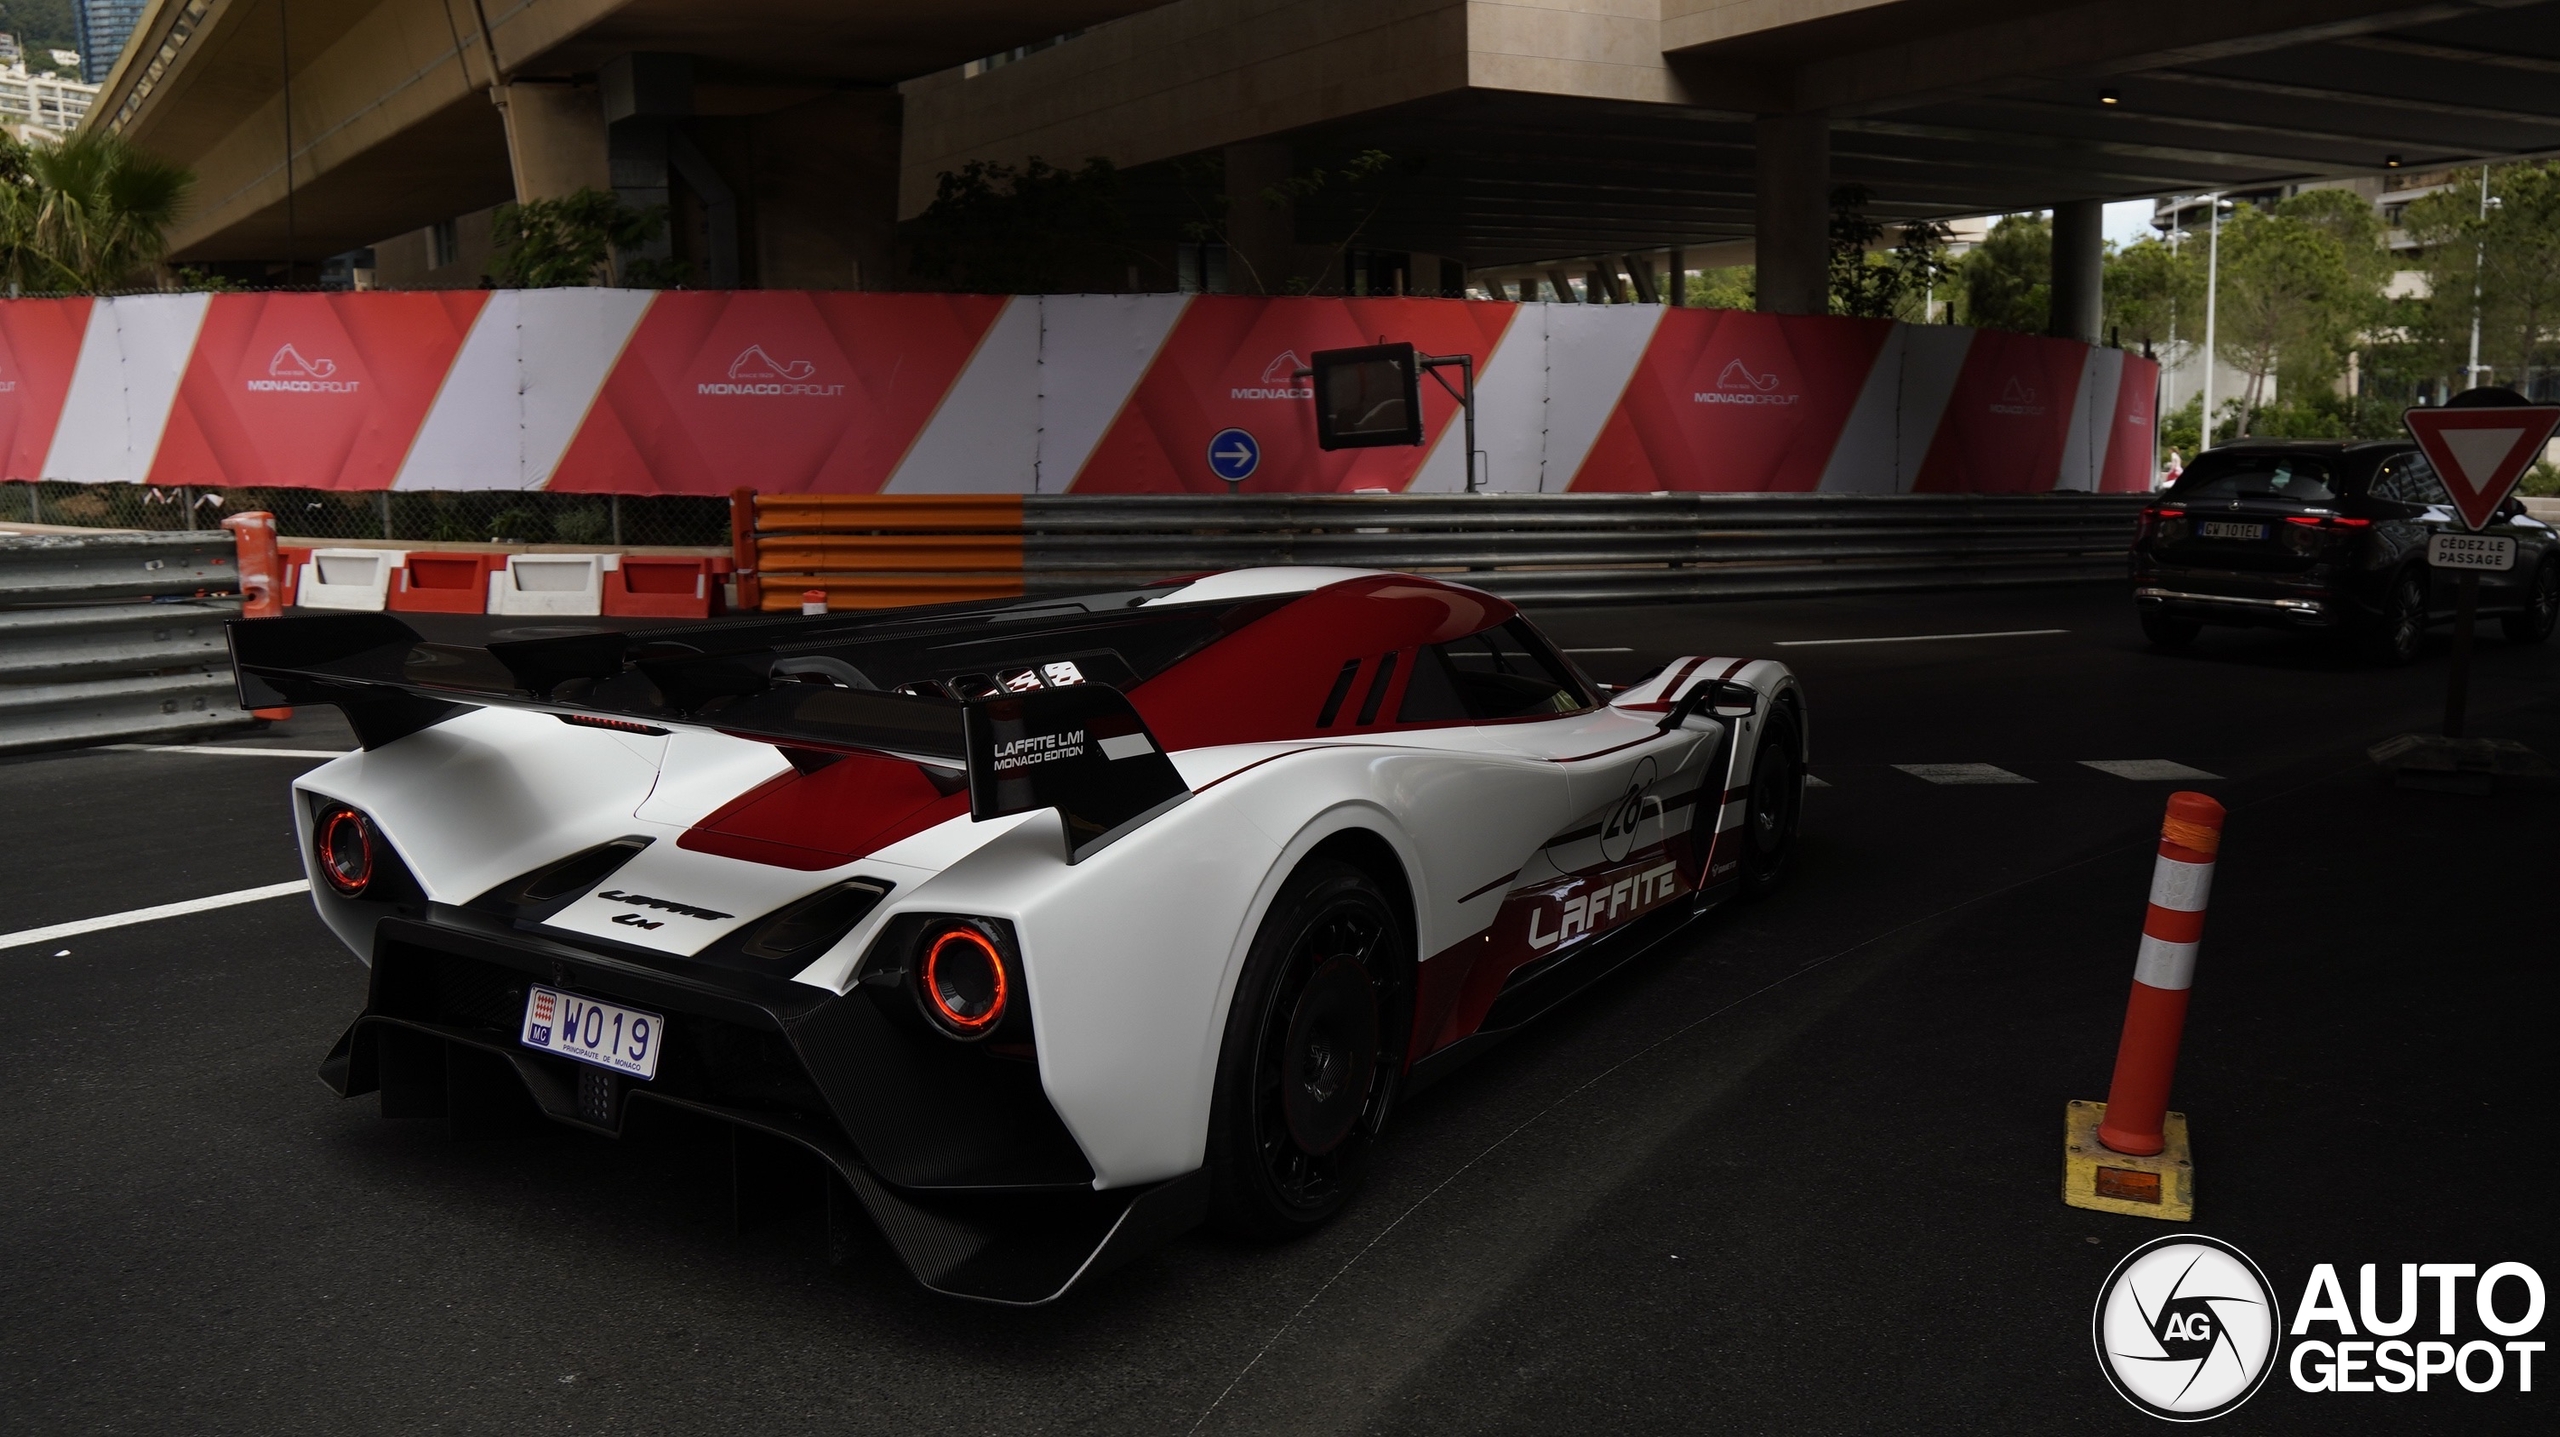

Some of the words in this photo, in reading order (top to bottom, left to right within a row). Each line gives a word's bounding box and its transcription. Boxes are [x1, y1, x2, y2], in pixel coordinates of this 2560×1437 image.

[1231, 388, 1314, 399] MONACO
[2205, 522, 2220, 535] GW
[2440, 537, 2485, 551] CÉDEZ
[2489, 541, 2505, 552] LE
[2438, 552, 2503, 566] PASSAGE
[994, 734, 1056, 758] LAFFITE
[1058, 729, 1084, 747] LM1
[994, 752, 1043, 771] MONACO
[1044, 745, 1084, 762] EDITION
[1528, 860, 1677, 950] LAFFITE
[532, 1026, 547, 1042] MC
[563, 998, 650, 1062] W019
[562, 1044, 599, 1060] PRINCIPAUTE
[602, 1055, 611, 1063] DE
[615, 1058, 642, 1072] MONACO
